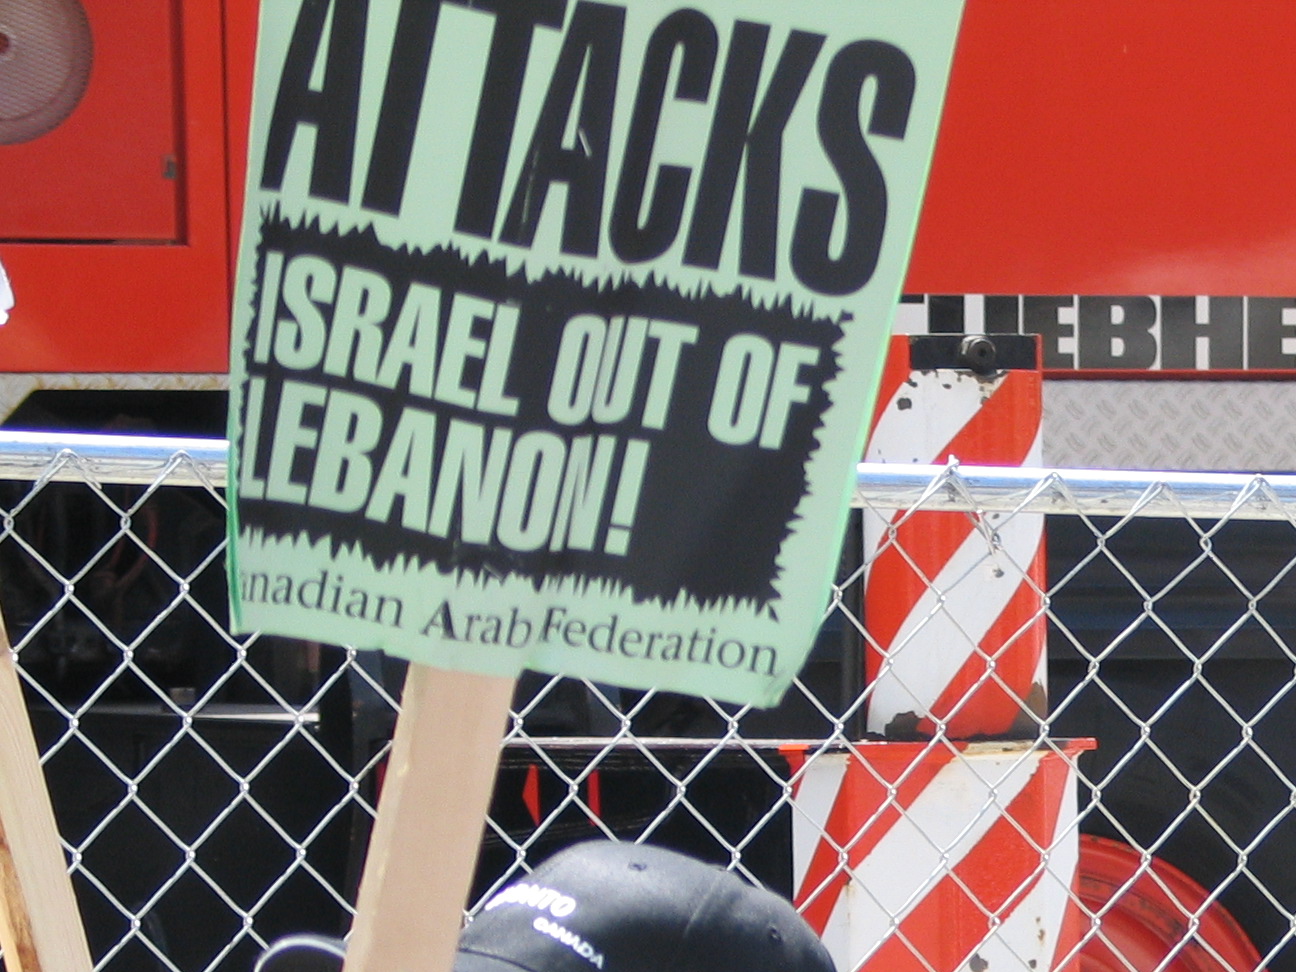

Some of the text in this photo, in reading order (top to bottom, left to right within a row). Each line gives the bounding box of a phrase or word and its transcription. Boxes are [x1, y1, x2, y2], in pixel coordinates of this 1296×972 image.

[259, 0, 917, 297] ATTACKS
[253, 250, 820, 451] ISRAEL OUT OF
[239, 376, 650, 557] LEBANON!
[419, 598, 533, 651] Arab
[538, 605, 781, 678] Federation
